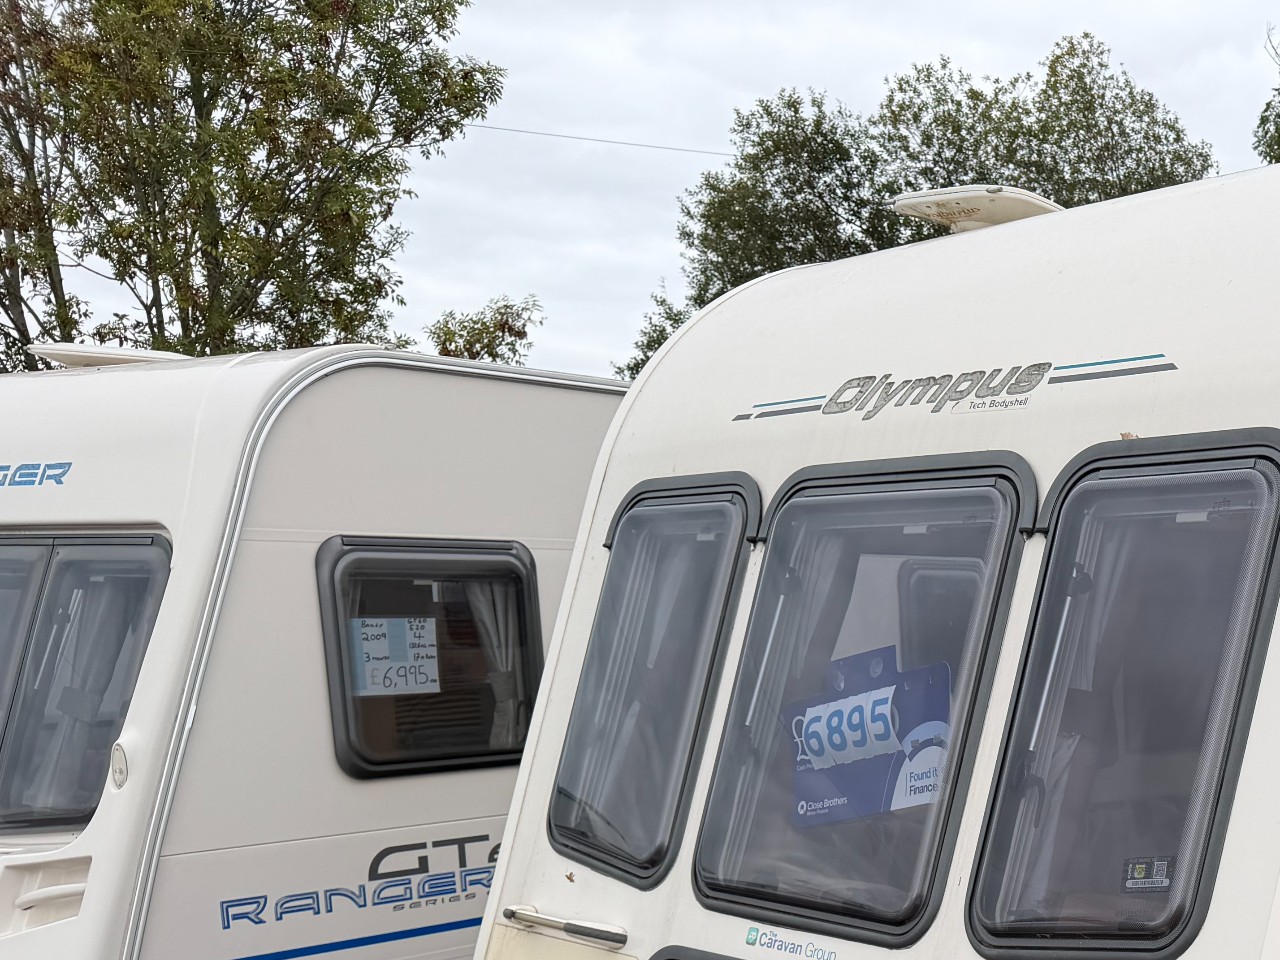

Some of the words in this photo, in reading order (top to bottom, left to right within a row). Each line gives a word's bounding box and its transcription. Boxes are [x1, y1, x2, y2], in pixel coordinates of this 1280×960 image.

[822, 362, 1052, 421] Olympus
[969, 400, 986, 409] Tech
[989, 397, 1029, 408] Bodyshell
[361, 632, 387, 641] 2009
[413, 632, 424, 640] 4
[364, 652, 370, 662] 3
[910, 768, 931, 783] Found
[807, 801, 823, 810] Close
[824, 797, 848, 807] Brothers
[368, 834, 502, 881] GT
[219, 866, 495, 930] RANGER
[392, 893, 476, 912] SERIES
[759, 933, 802, 955] Caravan
